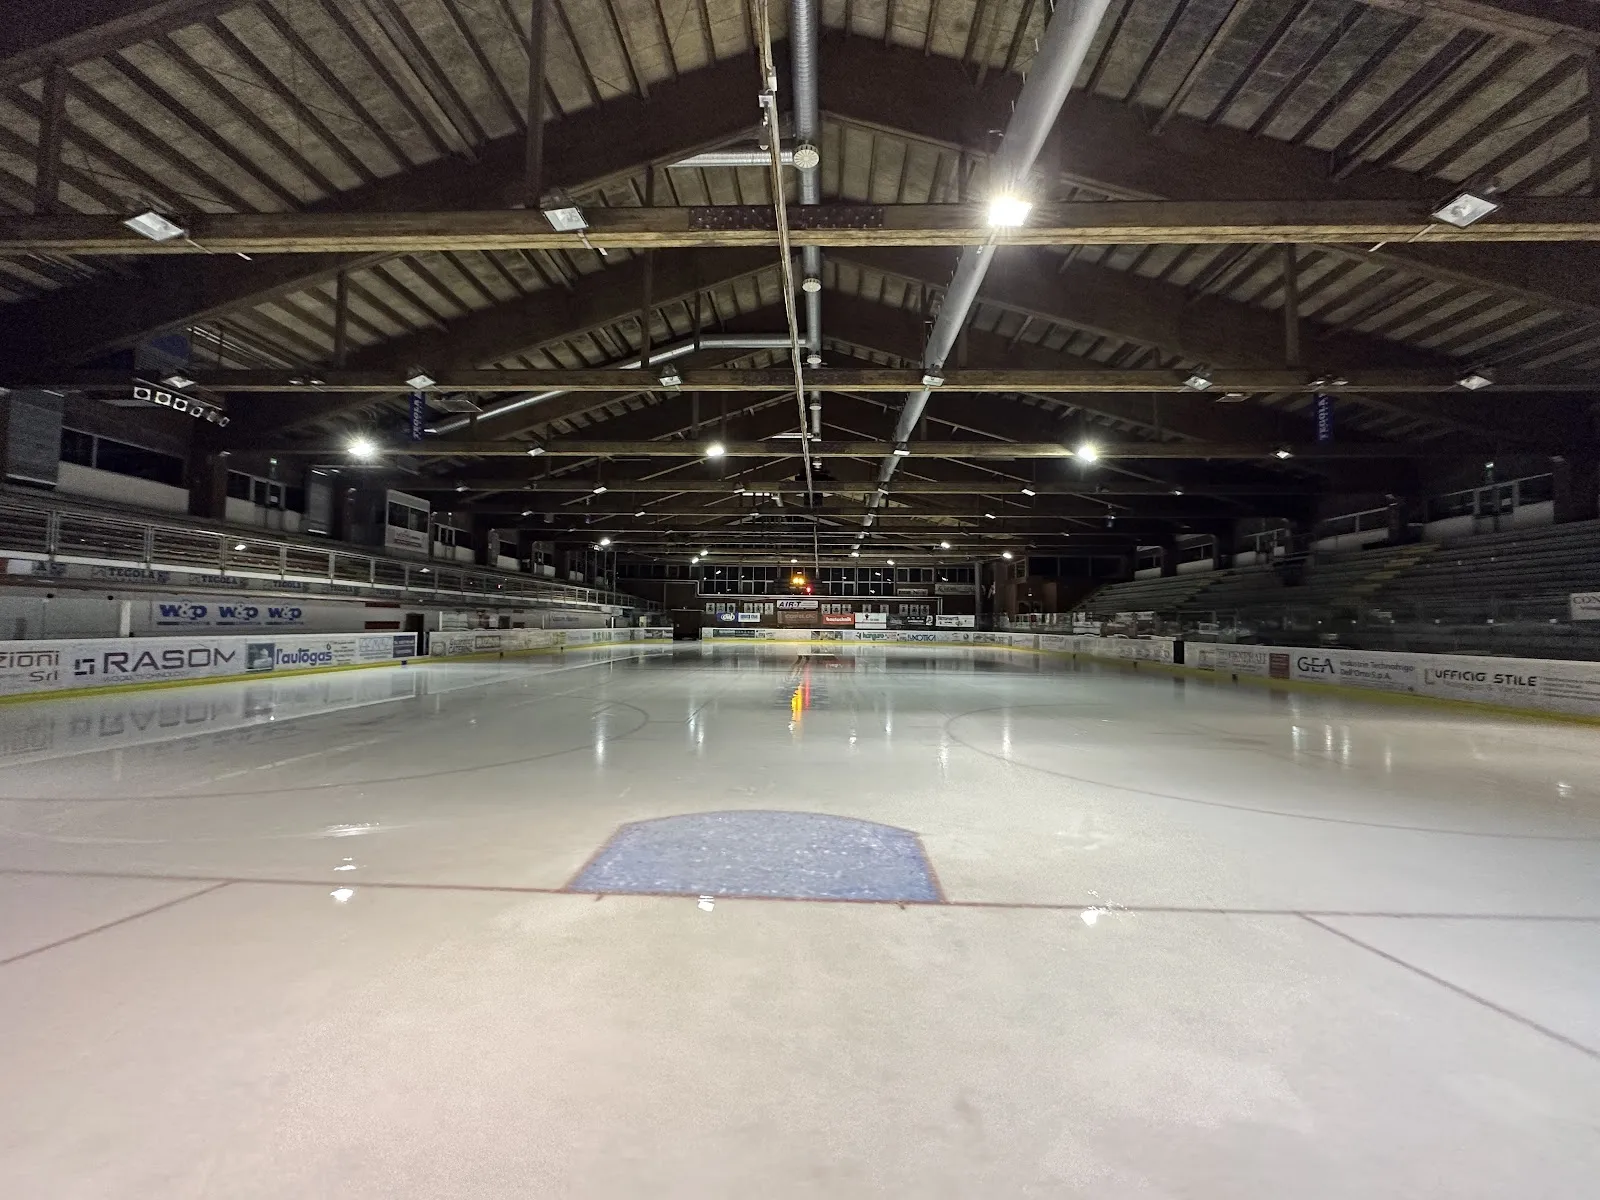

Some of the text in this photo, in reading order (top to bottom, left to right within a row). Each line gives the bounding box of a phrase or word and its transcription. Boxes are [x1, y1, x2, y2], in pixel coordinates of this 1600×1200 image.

[103, 648, 236, 674] RASOM
[1297, 656, 1335, 674] GEA
[1494, 674, 1538, 687] STILE
